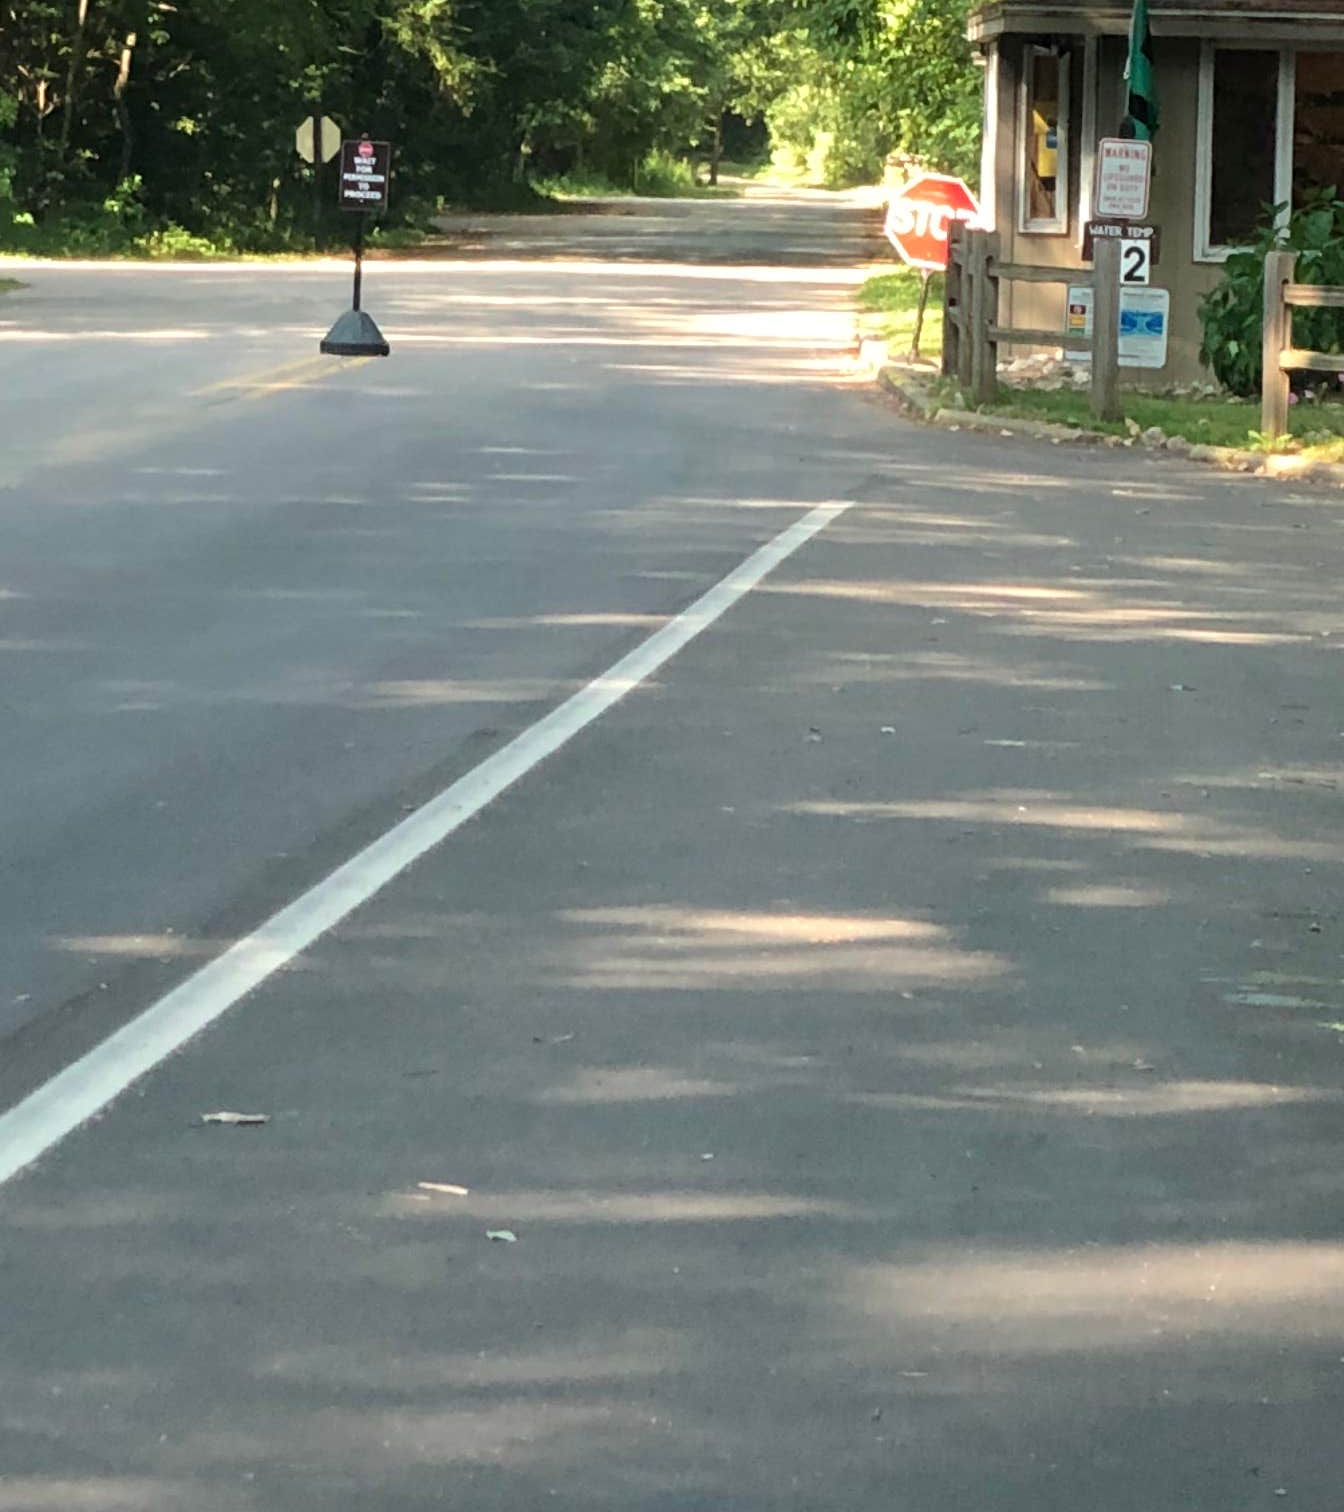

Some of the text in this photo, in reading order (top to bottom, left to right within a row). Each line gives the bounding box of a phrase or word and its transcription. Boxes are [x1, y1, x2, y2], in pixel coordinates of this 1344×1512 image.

[1104, 148, 1146, 160] WARNING
[354, 156, 376, 165] WAIT
[344, 189, 382, 200] PROCEED
[1088, 223, 1121, 237] WATER
[1123, 246, 1146, 282] 2
